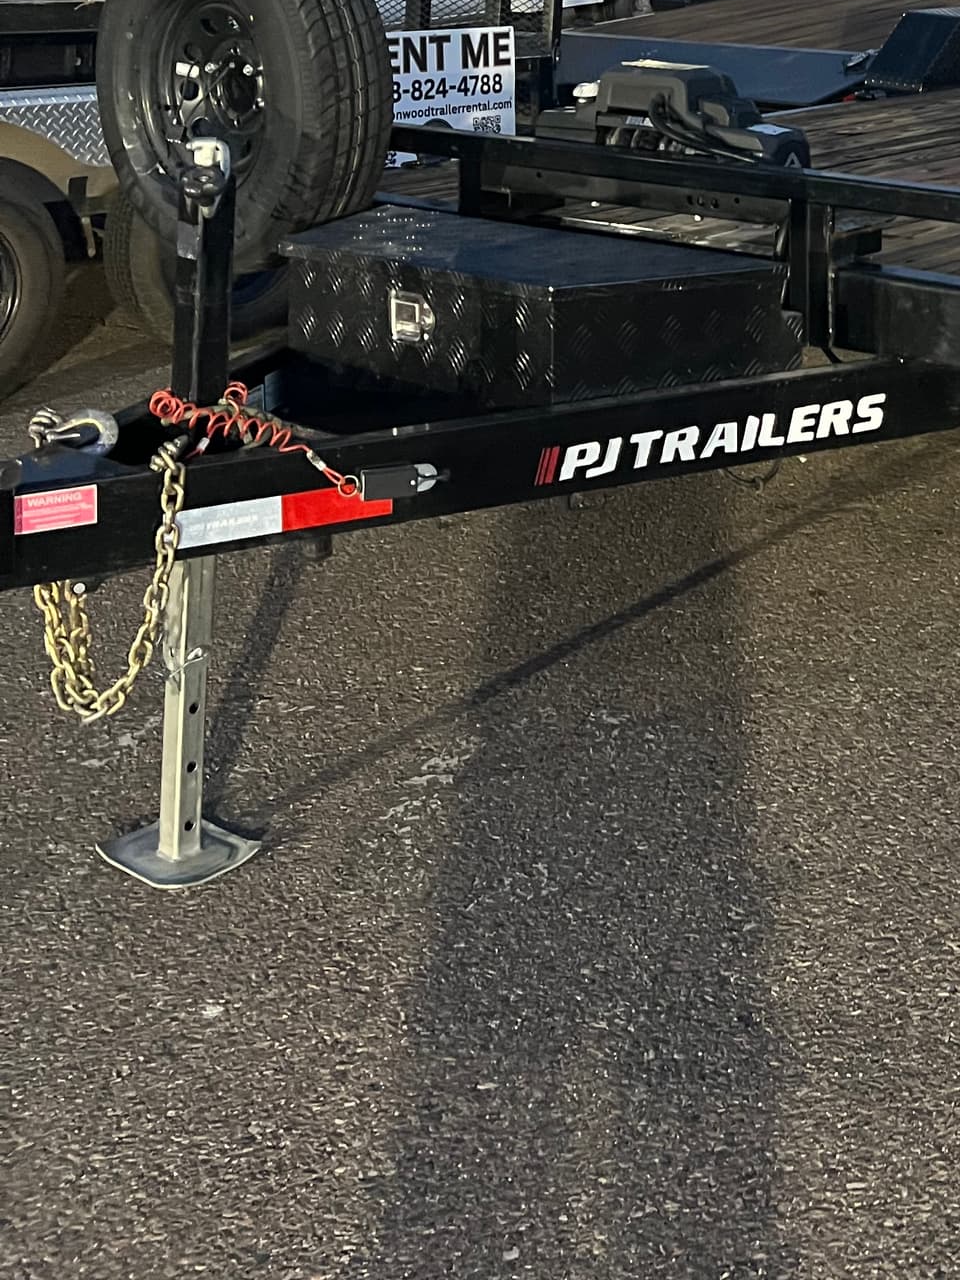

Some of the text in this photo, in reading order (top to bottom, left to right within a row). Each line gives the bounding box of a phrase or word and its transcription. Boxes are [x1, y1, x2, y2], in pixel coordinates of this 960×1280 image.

[461, 32, 511, 69] ME
[559, 392, 886, 482] PJ TRAILERS
[27, 492, 82, 507] WARNING
